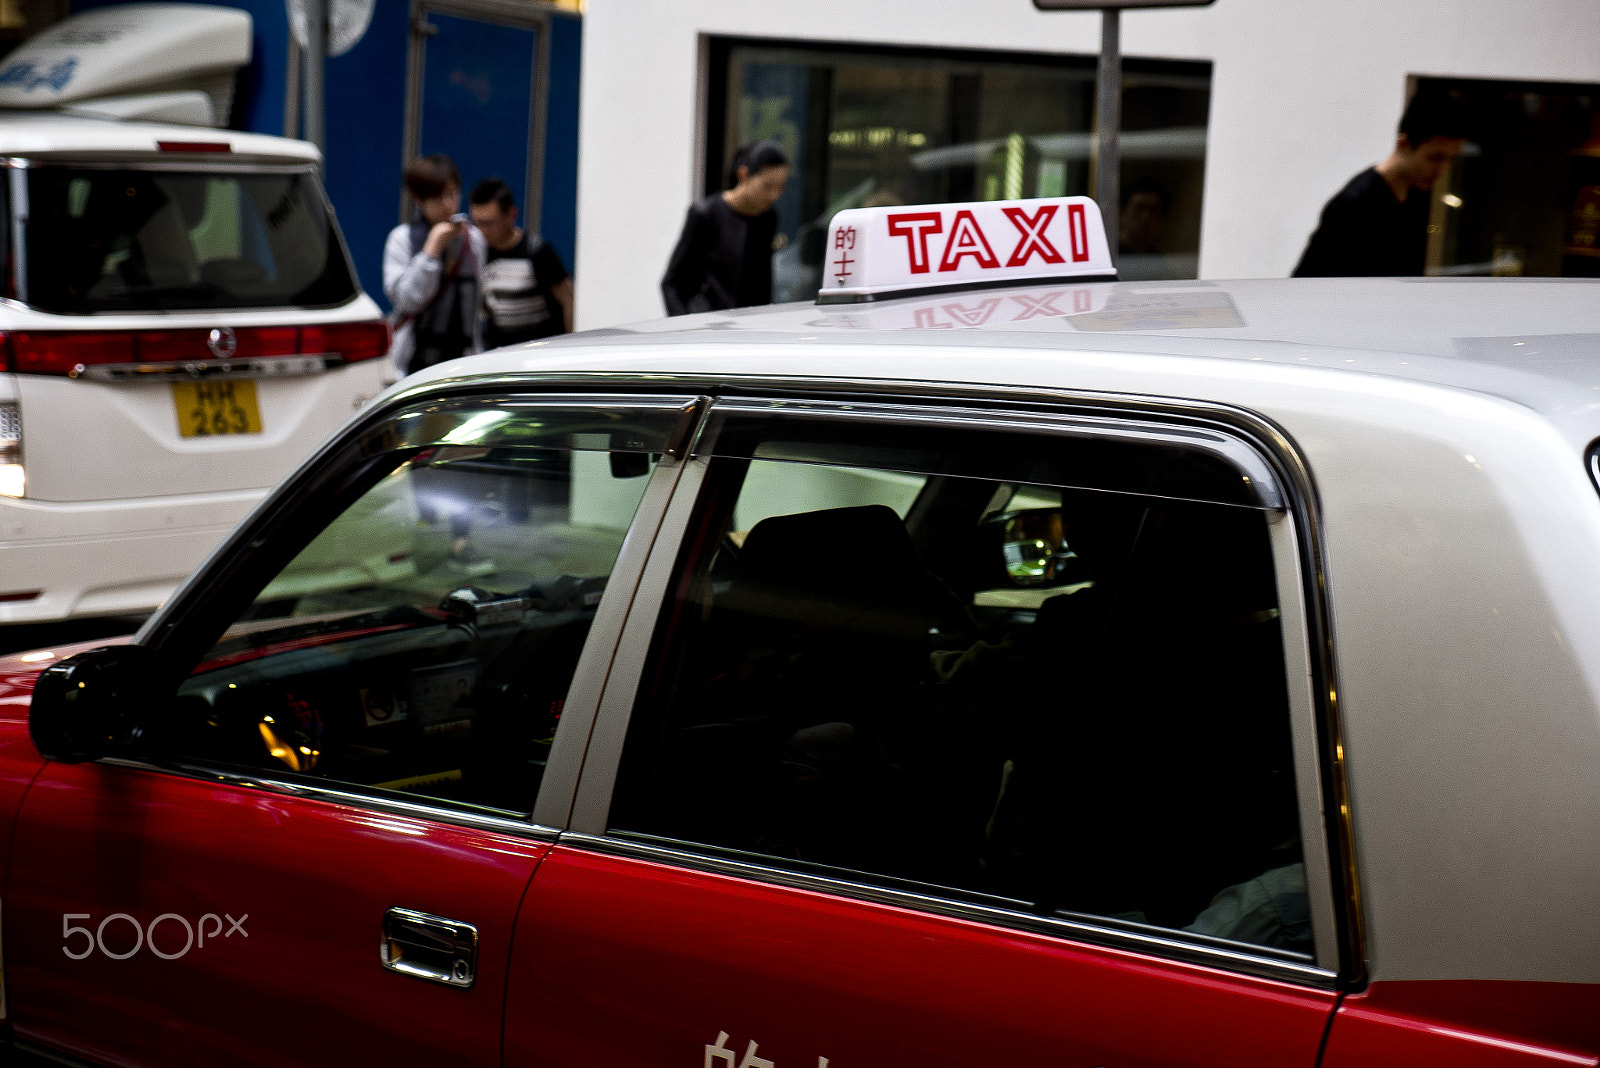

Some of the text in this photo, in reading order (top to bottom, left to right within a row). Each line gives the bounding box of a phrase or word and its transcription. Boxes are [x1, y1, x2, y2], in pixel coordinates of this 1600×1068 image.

[833, 225, 856, 277] 的士
[887, 203, 1090, 275] TAXI
[190, 405, 250, 437] 263
